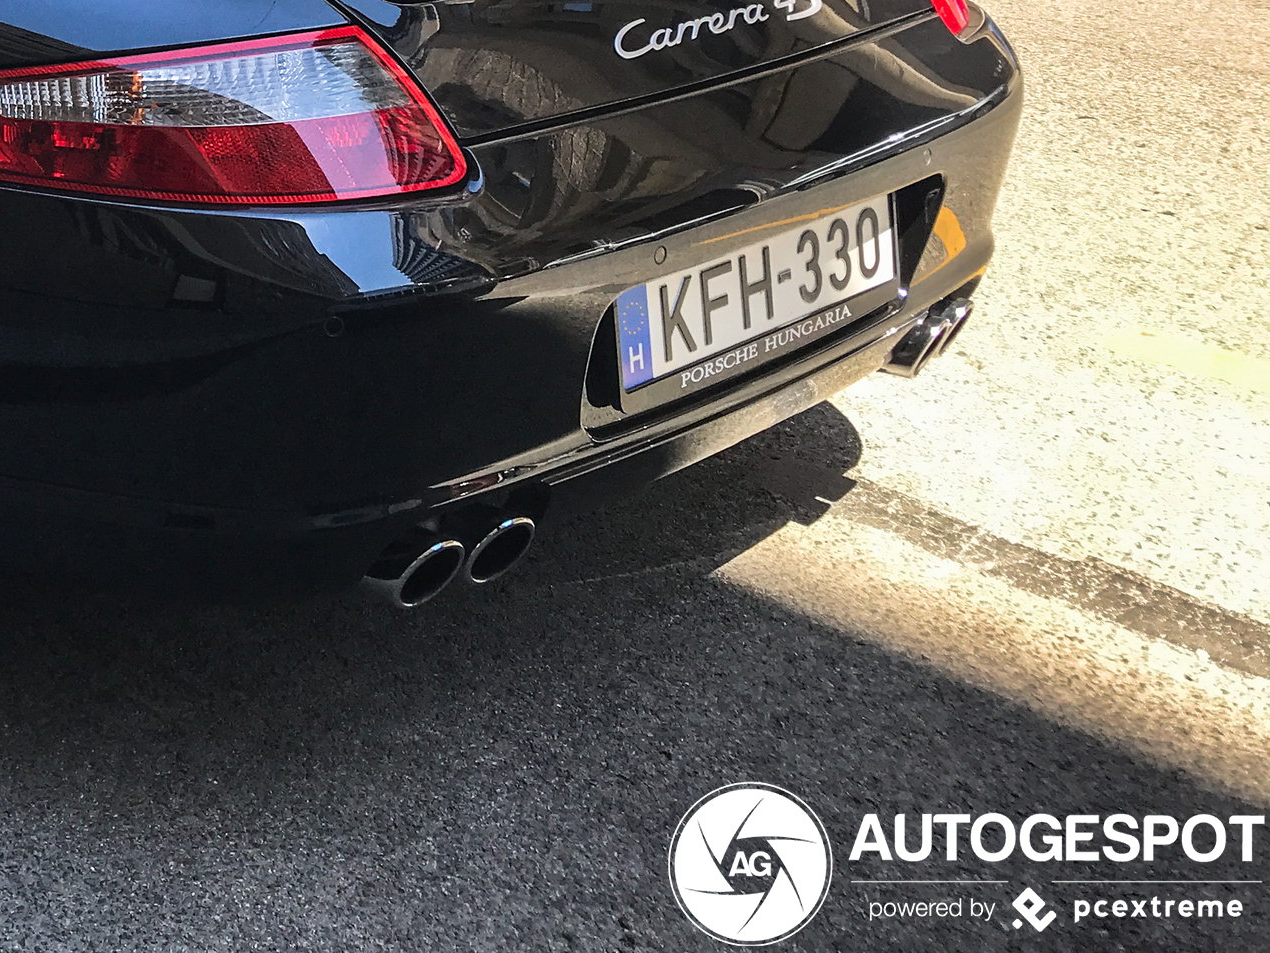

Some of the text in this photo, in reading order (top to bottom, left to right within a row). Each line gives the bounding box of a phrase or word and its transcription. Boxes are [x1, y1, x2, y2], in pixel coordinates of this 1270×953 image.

[614, 3, 770, 60] Carrera
[628, 206, 881, 375] H KFH-330
[679, 304, 853, 389] PORSCHE HUNGARIA
